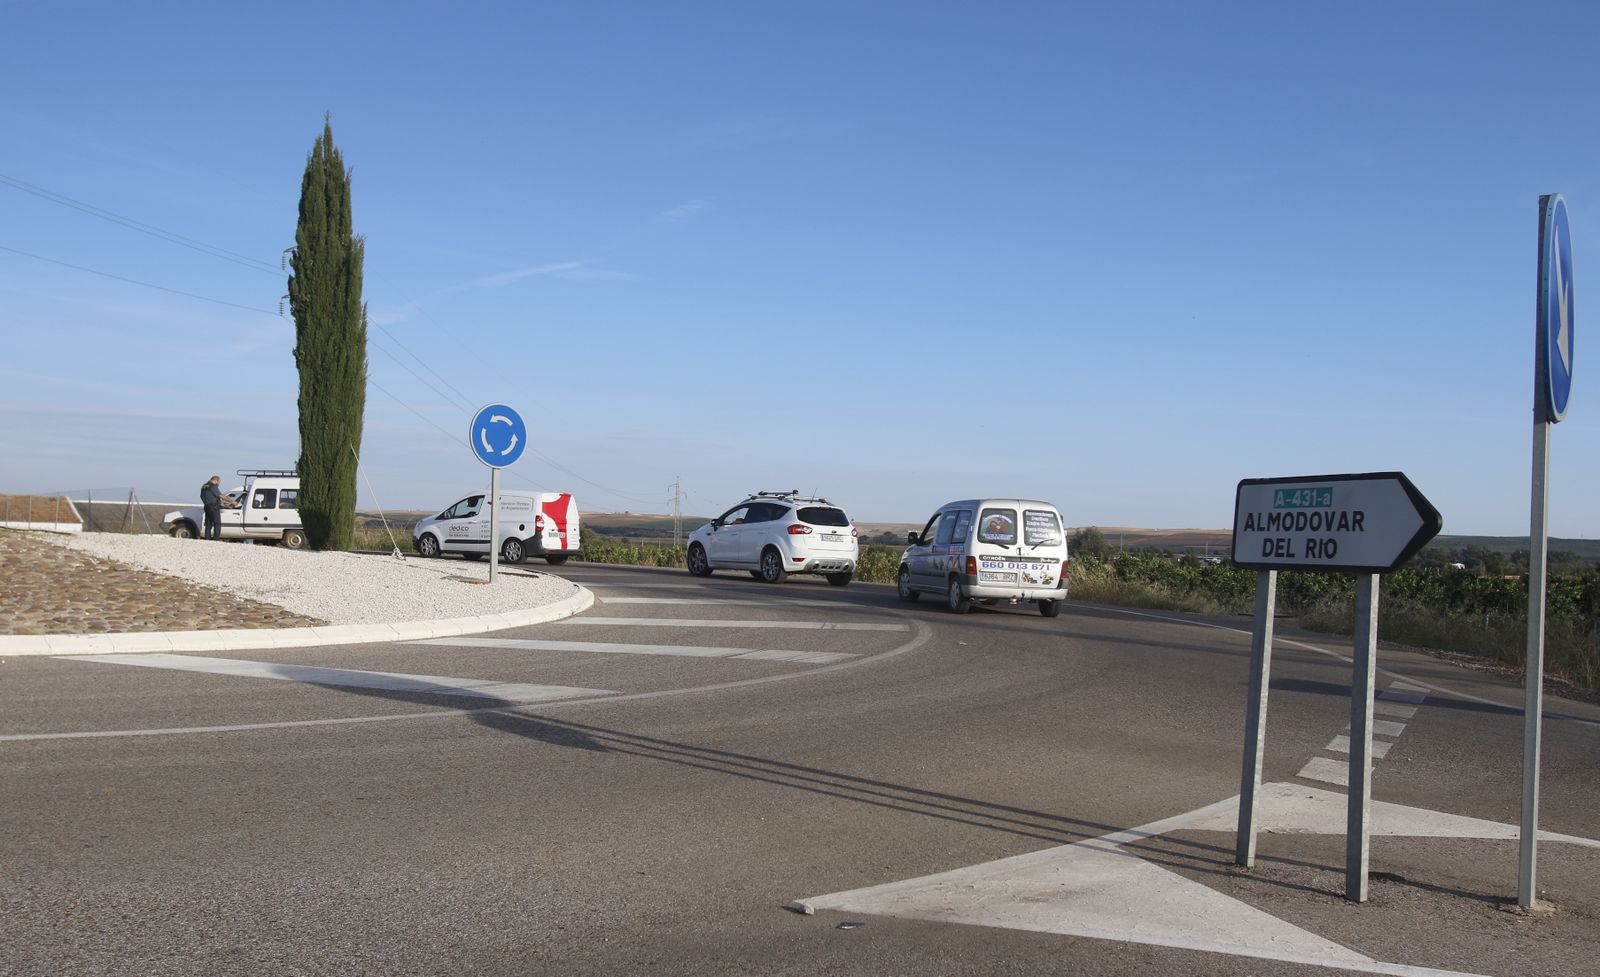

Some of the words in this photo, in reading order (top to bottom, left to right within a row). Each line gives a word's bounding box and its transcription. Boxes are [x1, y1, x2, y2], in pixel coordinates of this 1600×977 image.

[1275, 489, 1331, 507] A-431-a
[1244, 511, 1365, 532] ALMODOVAR
[1262, 538, 1296, 558] DEL
[1305, 538, 1338, 559] RIO
[1008, 562, 1028, 570] 013
